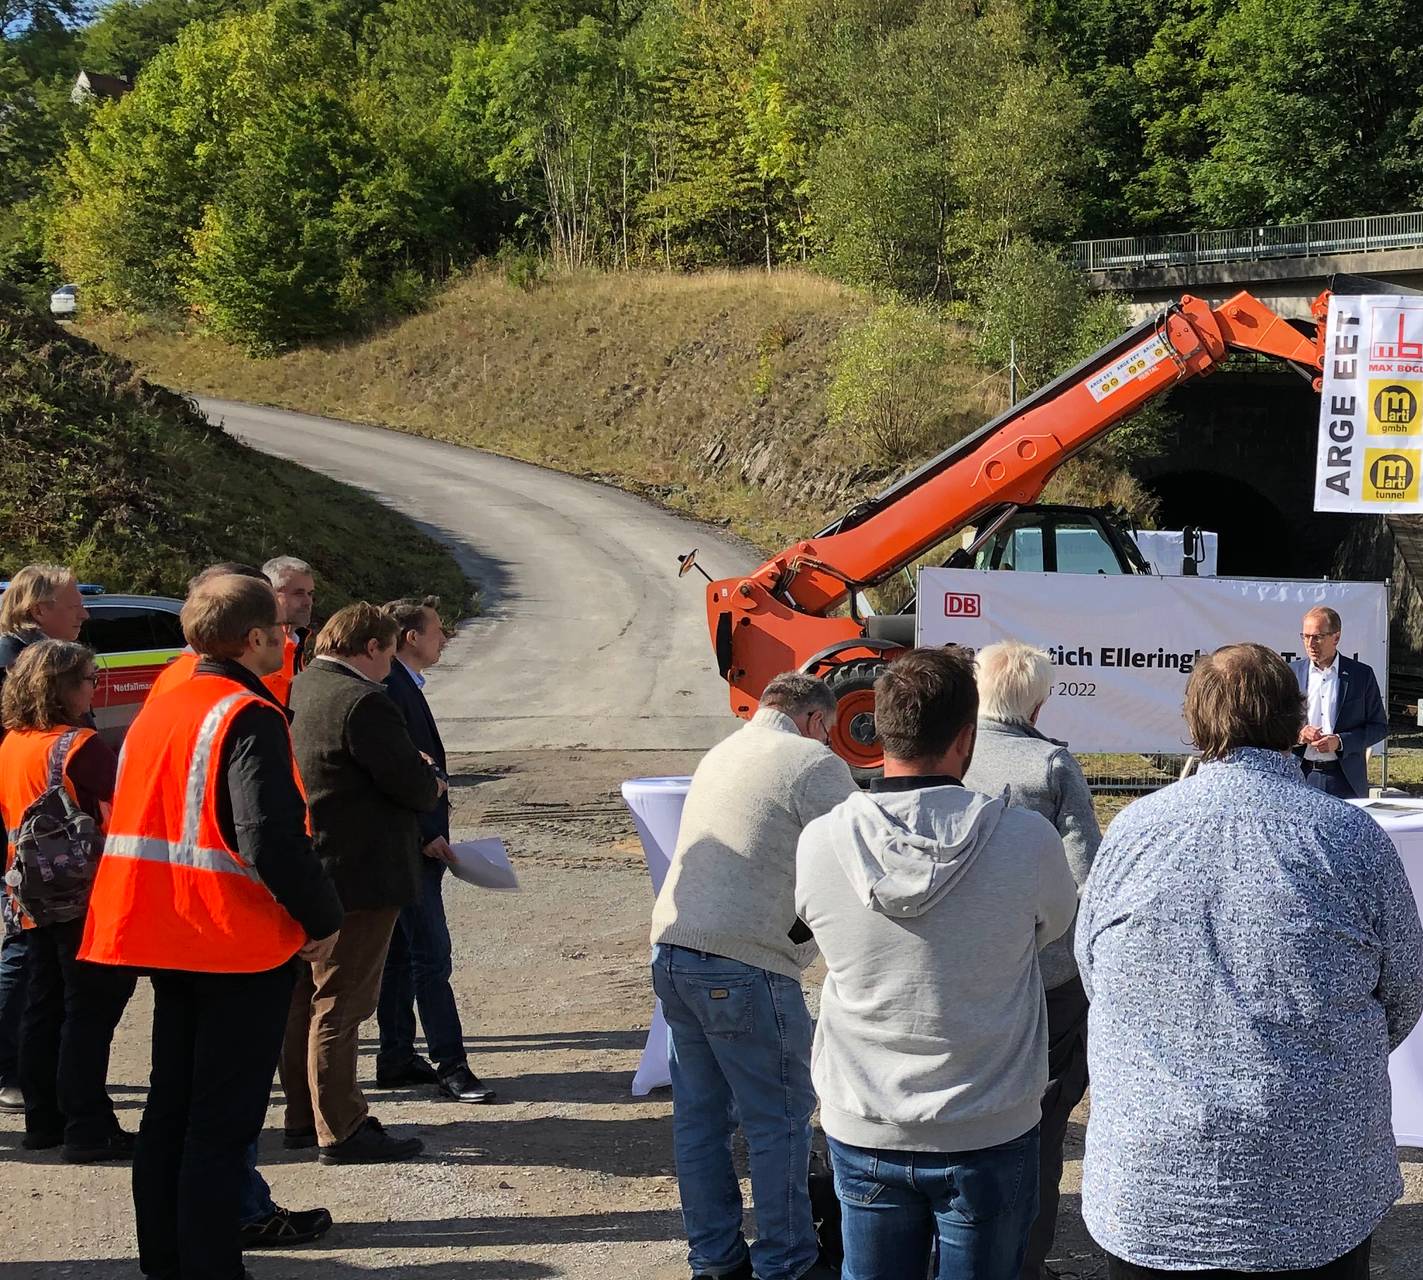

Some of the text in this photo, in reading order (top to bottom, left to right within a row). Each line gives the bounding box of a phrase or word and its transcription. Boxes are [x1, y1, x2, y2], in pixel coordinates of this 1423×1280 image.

[1326, 310, 1360, 496] ARGE EET
[1382, 424, 1408, 434] gmbh
[1376, 491, 1405, 499] tunnel
[949, 596, 977, 614] DB
[1058, 682, 1096, 697] 2022
